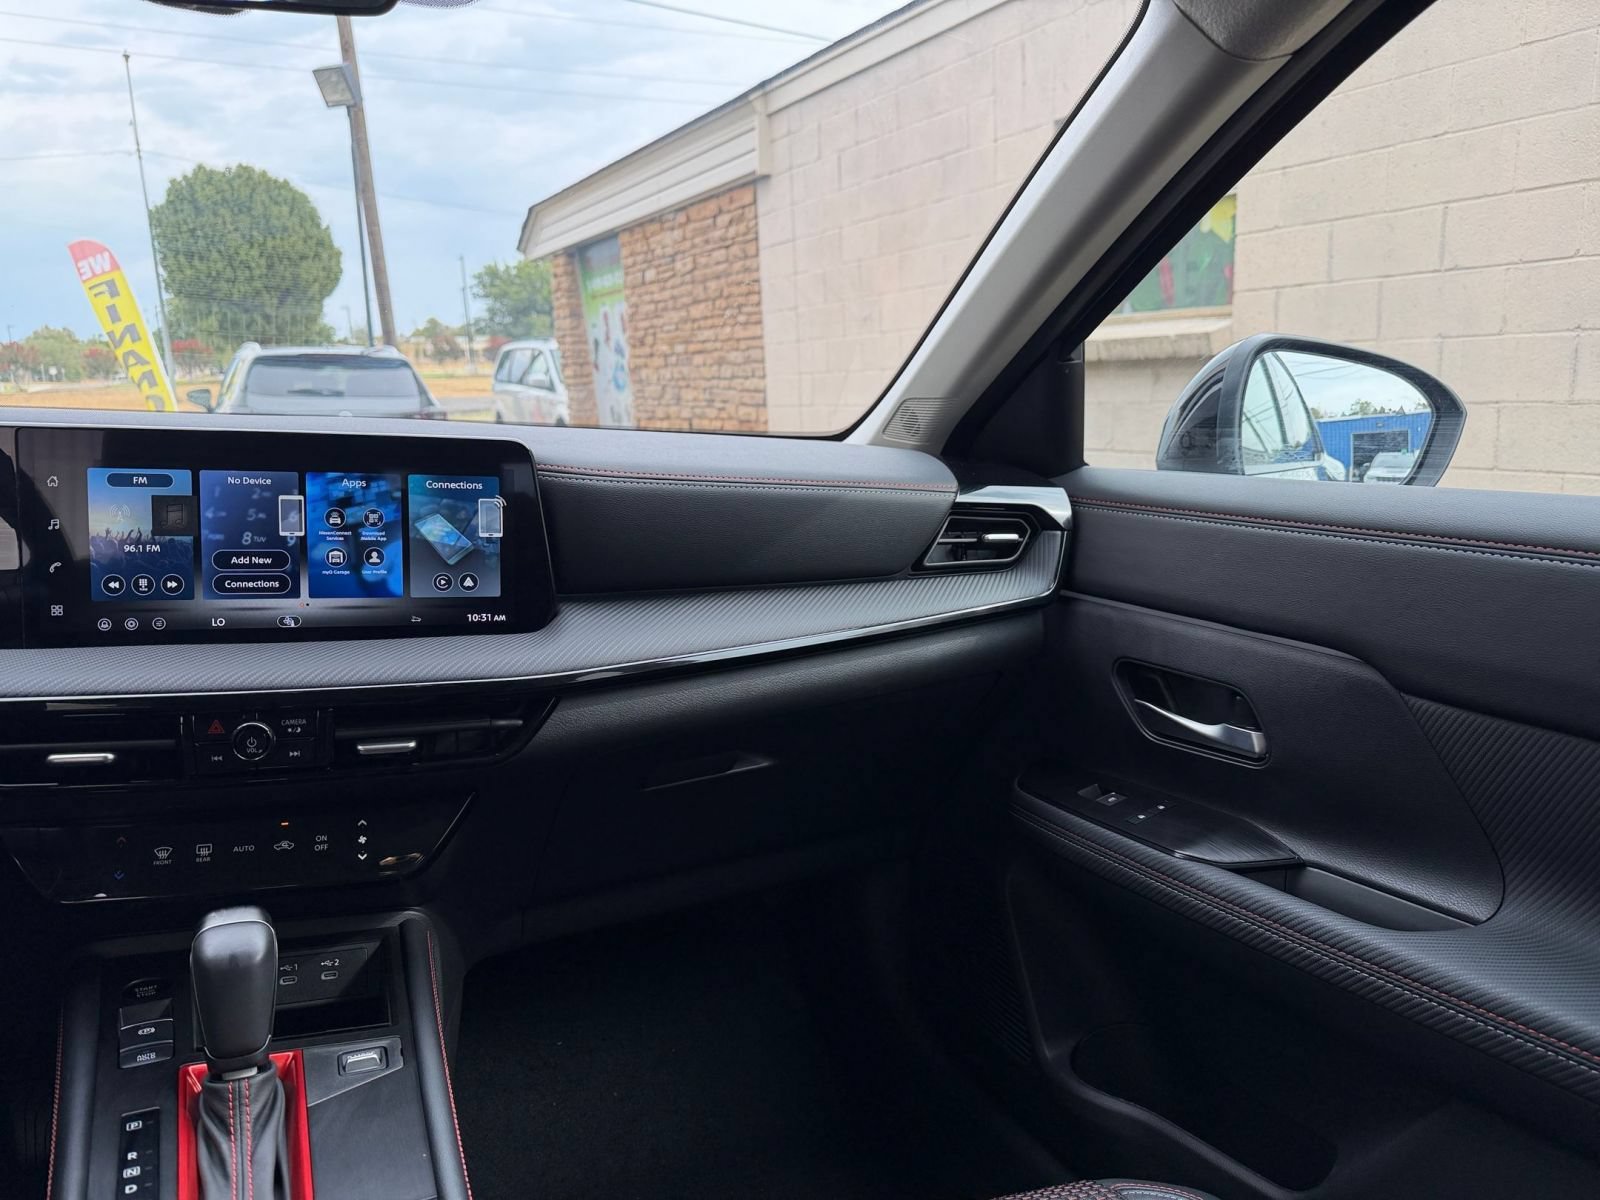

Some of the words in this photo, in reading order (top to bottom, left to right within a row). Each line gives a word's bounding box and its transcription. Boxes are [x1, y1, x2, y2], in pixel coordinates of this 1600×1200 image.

[133, 476, 148, 484] FM
[342, 478, 366, 488] Apps
[426, 480, 483, 490] Connections
[212, 618, 225, 627] LO
[467, 614, 492, 622] 10:31
[127, 1152, 138, 1160] R
[125, 1184, 137, 1194] D
